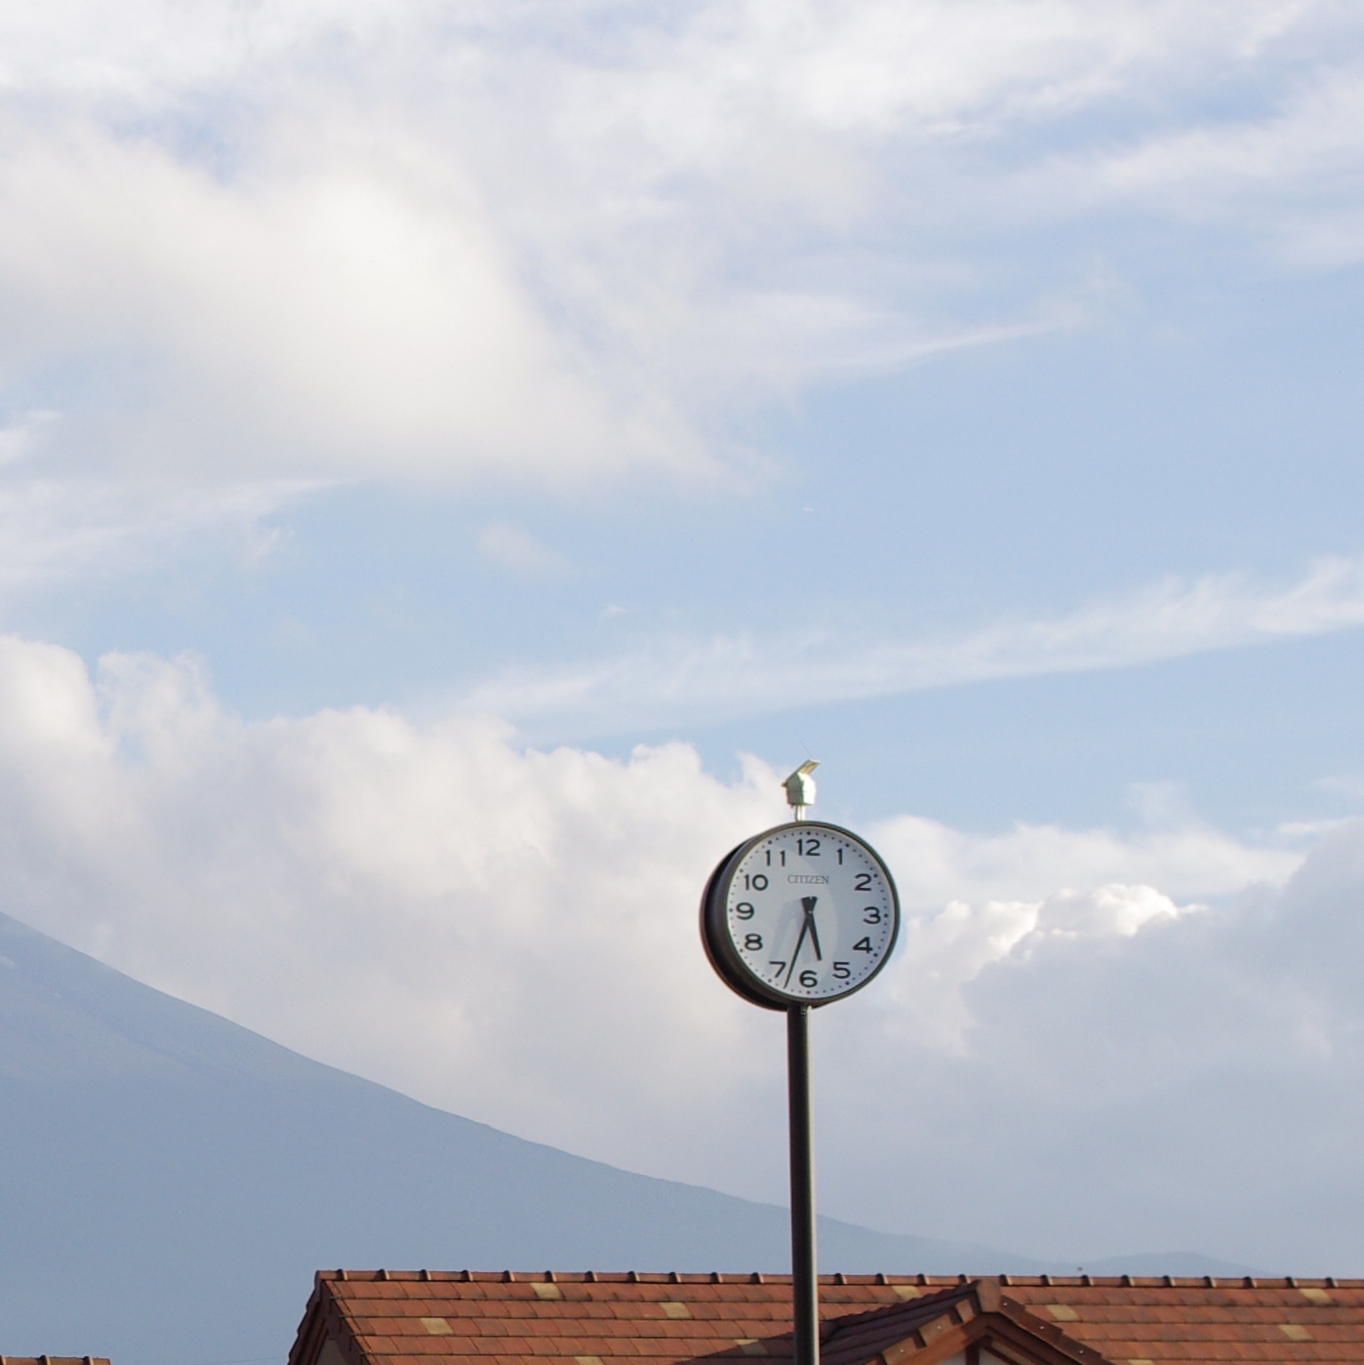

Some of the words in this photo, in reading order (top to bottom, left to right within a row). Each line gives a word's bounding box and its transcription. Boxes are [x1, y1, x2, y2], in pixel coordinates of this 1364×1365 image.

[796, 839, 820, 856] 12
[765, 850, 787, 867] 11
[836, 848, 843, 865] 1
[744, 874, 769, 891] 10
[787, 875, 830, 884] CITIZEN
[854, 873, 872, 891] 2
[735, 902, 755, 920] 9
[863, 907, 881, 925] 3
[744, 934, 763, 951] 8
[852, 937, 873, 954] 4
[769, 961, 786, 978] 7
[832, 962, 852, 979] 5
[798, 970, 818, 988] 6
